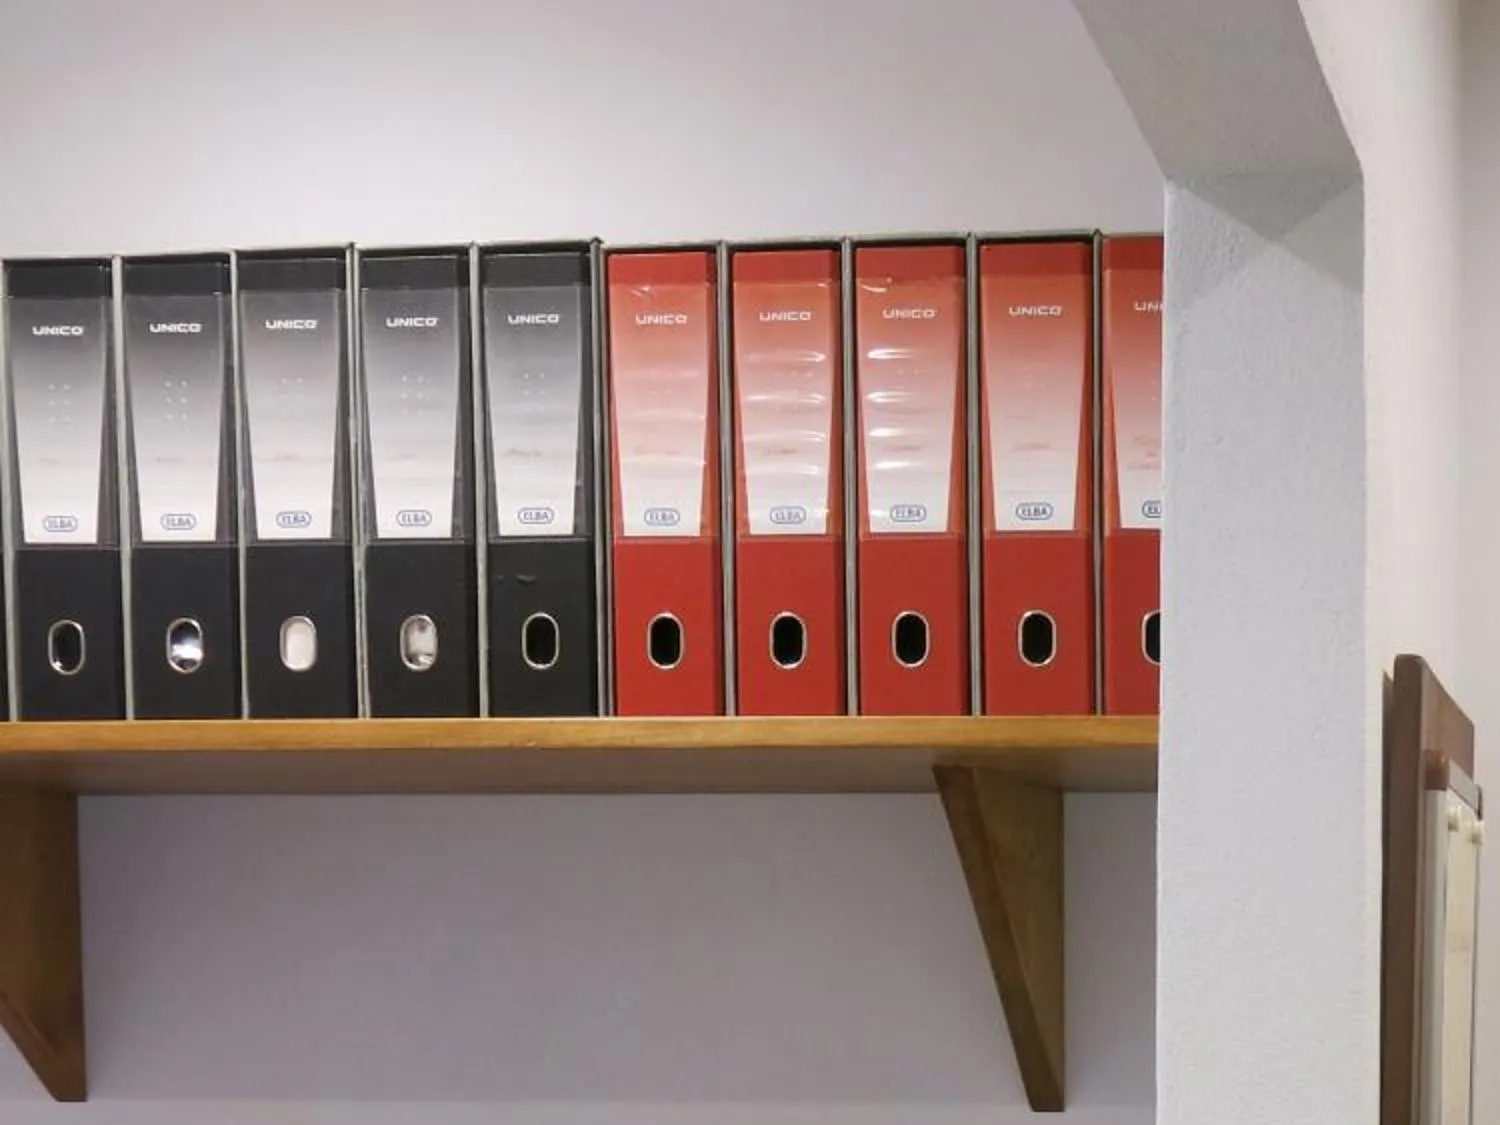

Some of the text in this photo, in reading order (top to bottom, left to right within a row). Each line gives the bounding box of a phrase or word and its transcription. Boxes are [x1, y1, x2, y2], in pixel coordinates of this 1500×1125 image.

[1009, 305, 1063, 317] UNICO
[1134, 301, 1164, 313] UNI
[507, 313, 561, 325] UNICO
[635, 313, 688, 325] UNICO
[759, 311, 813, 322] UNICO
[882, 308, 937, 319] UNICO
[149, 322, 203, 334] UNICO
[265, 319, 318, 330] UNICO
[385, 316, 439, 328] UNICO
[31, 325, 84, 337] UNICO
[401, 511, 427, 523] ELBA
[522, 509, 550, 521] ELBA
[649, 510, 675, 521] ELBA
[774, 509, 801, 521] ELBA
[894, 507, 921, 518] ELBA
[1020, 505, 1047, 517] ELBA
[48, 518, 74, 530] ELBA
[164, 515, 192, 527] ELBA
[281, 512, 307, 524] ELBA
